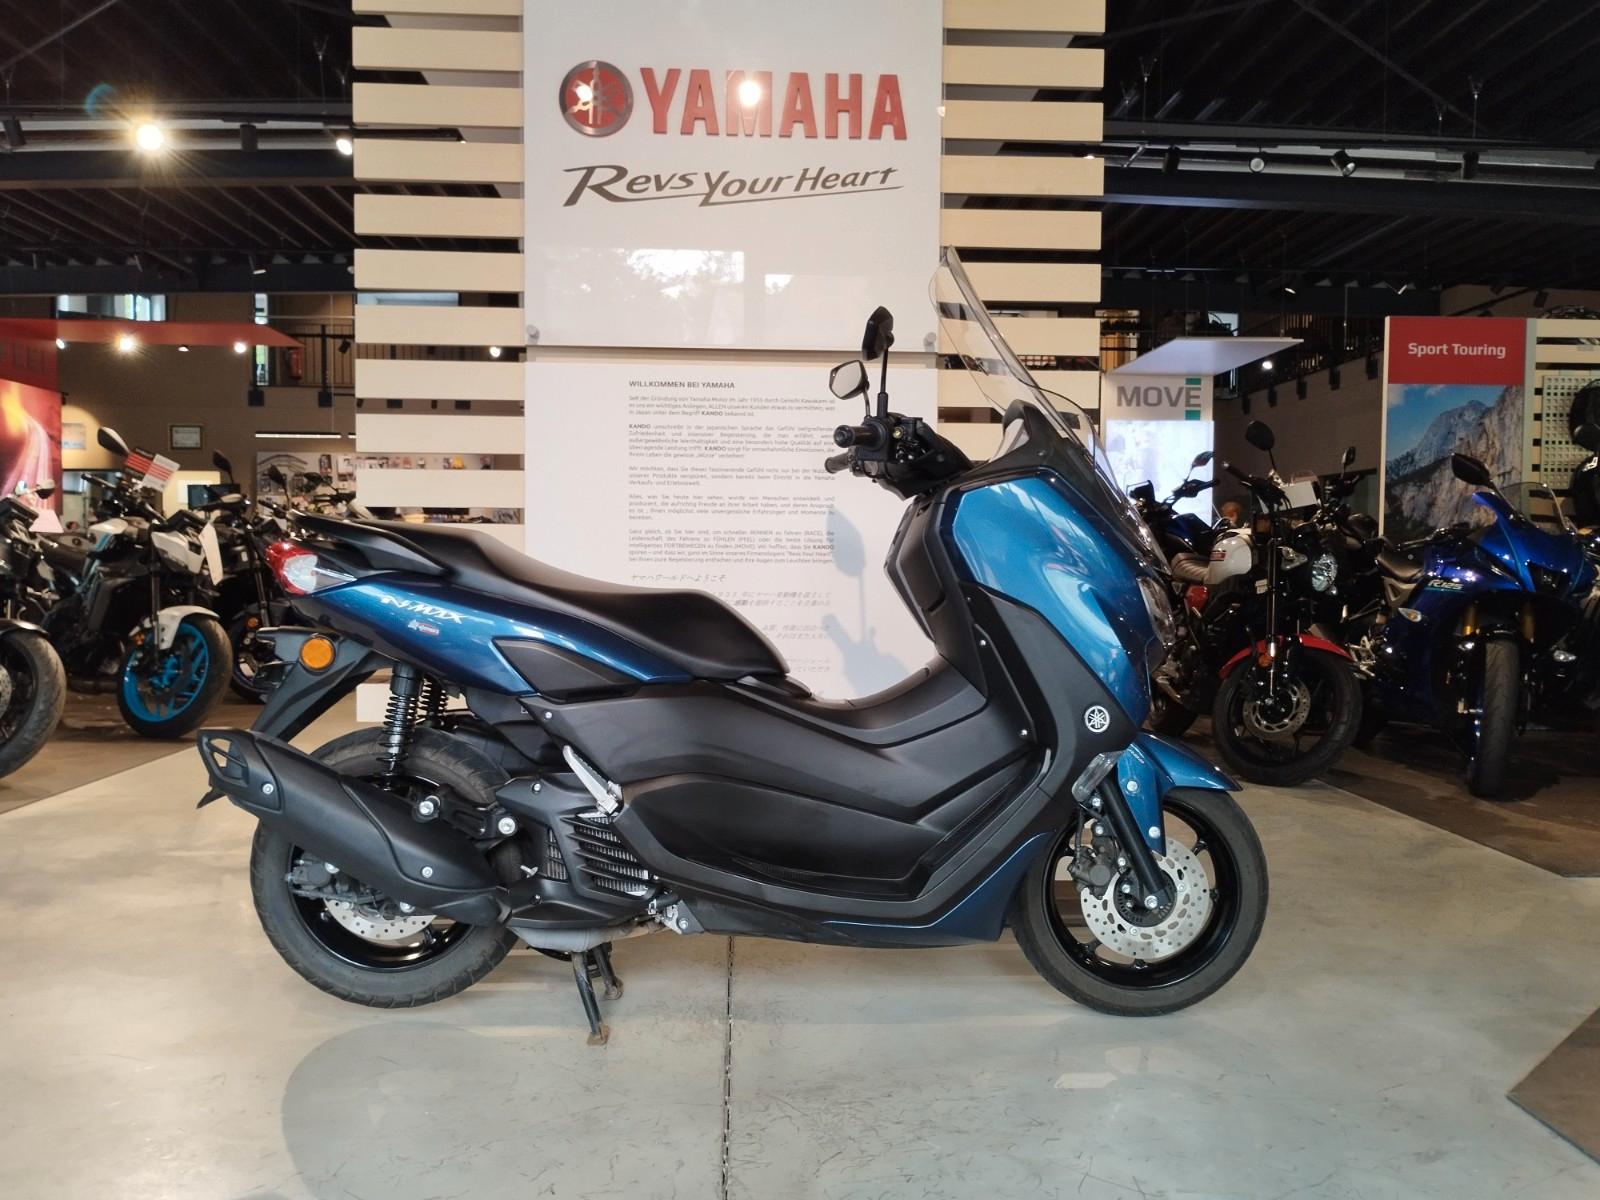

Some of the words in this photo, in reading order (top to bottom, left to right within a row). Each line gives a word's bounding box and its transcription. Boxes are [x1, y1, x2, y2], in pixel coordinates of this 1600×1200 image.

[640, 68, 908, 140] YAMAHA
[1408, 342, 1448, 358] Sport
[1452, 342, 1507, 359] Touring
[1116, 385, 1203, 408] MOVE
